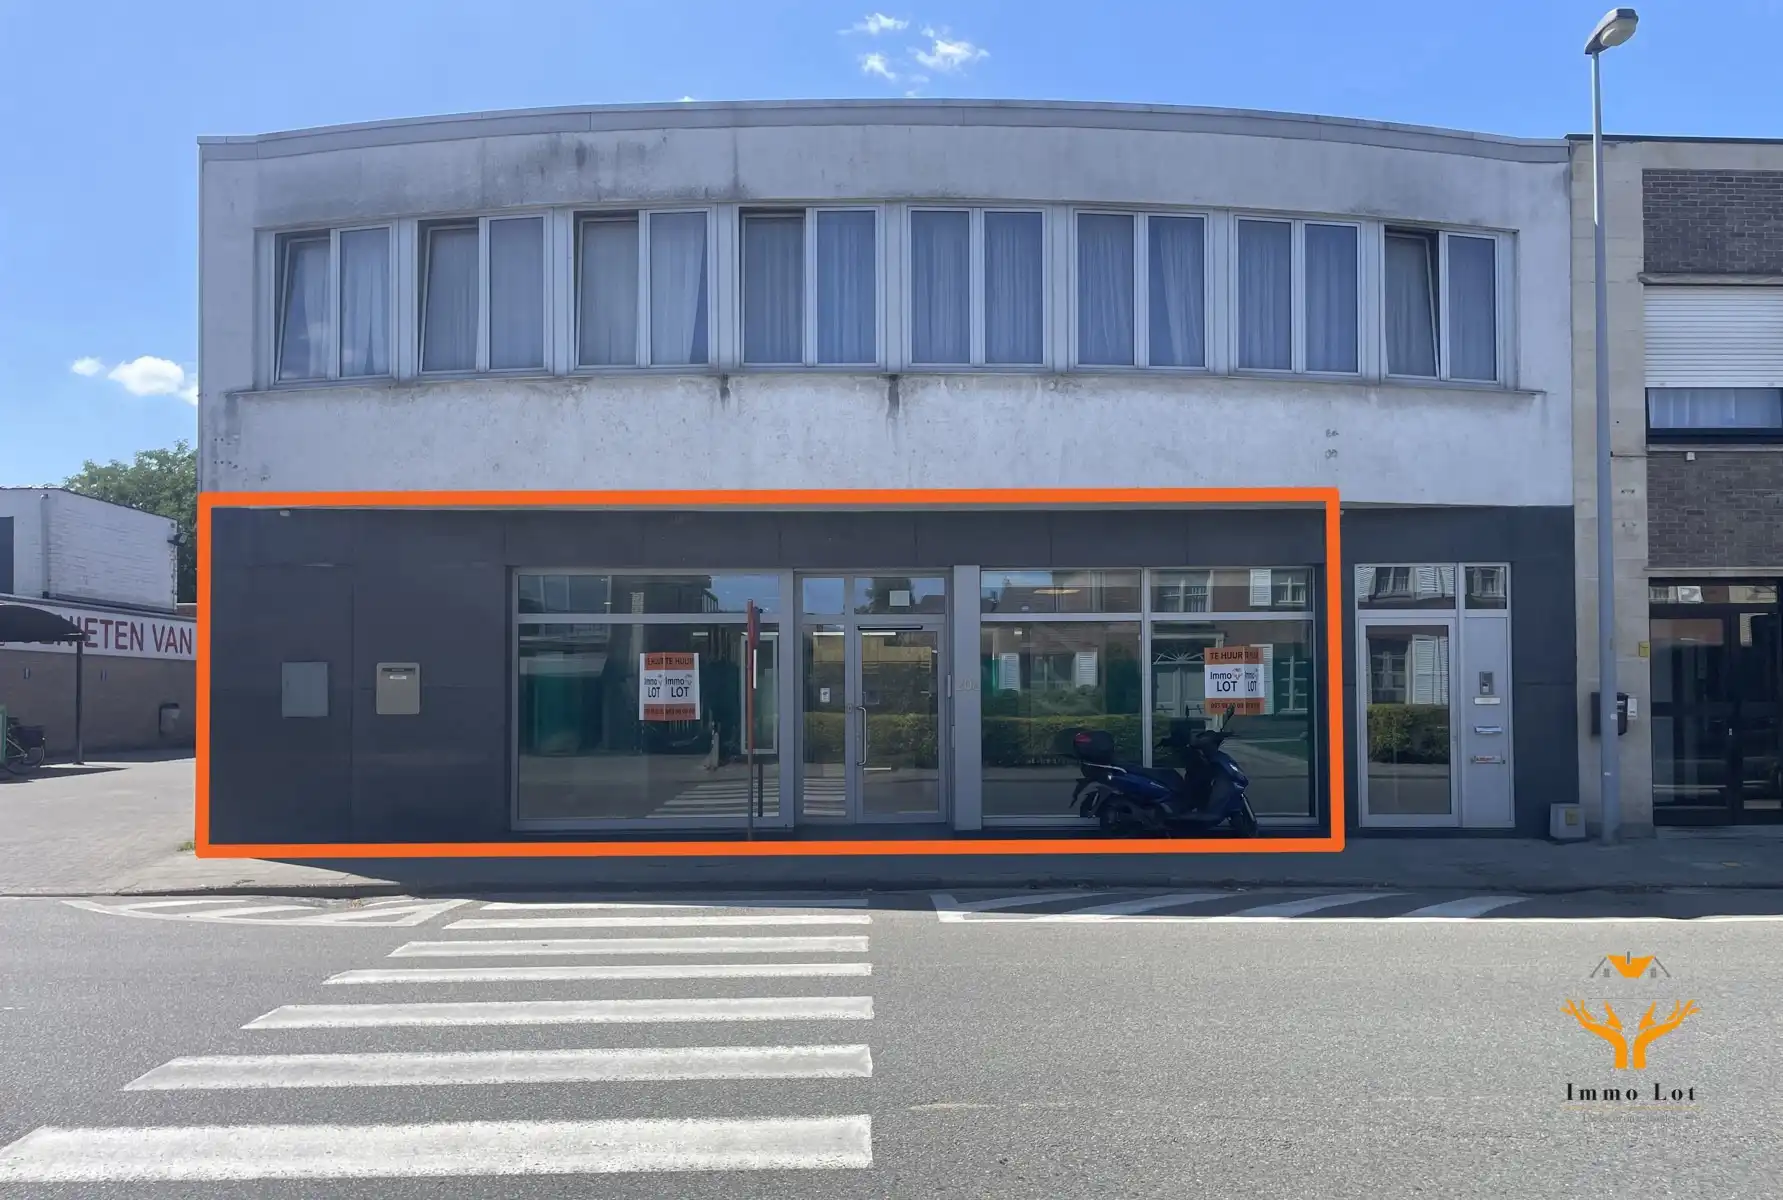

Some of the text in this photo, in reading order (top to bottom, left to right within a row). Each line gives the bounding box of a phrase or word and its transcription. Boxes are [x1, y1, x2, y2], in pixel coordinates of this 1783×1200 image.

[152, 623, 192, 654] VAN
[1220, 652, 1242, 660] HUUR
[665, 676, 684, 685] Immo
[1210, 672, 1232, 680] Immo
[1216, 681, 1238, 692] LOT
[648, 687, 660, 698] LOT
[672, 687, 690, 698] LOT
